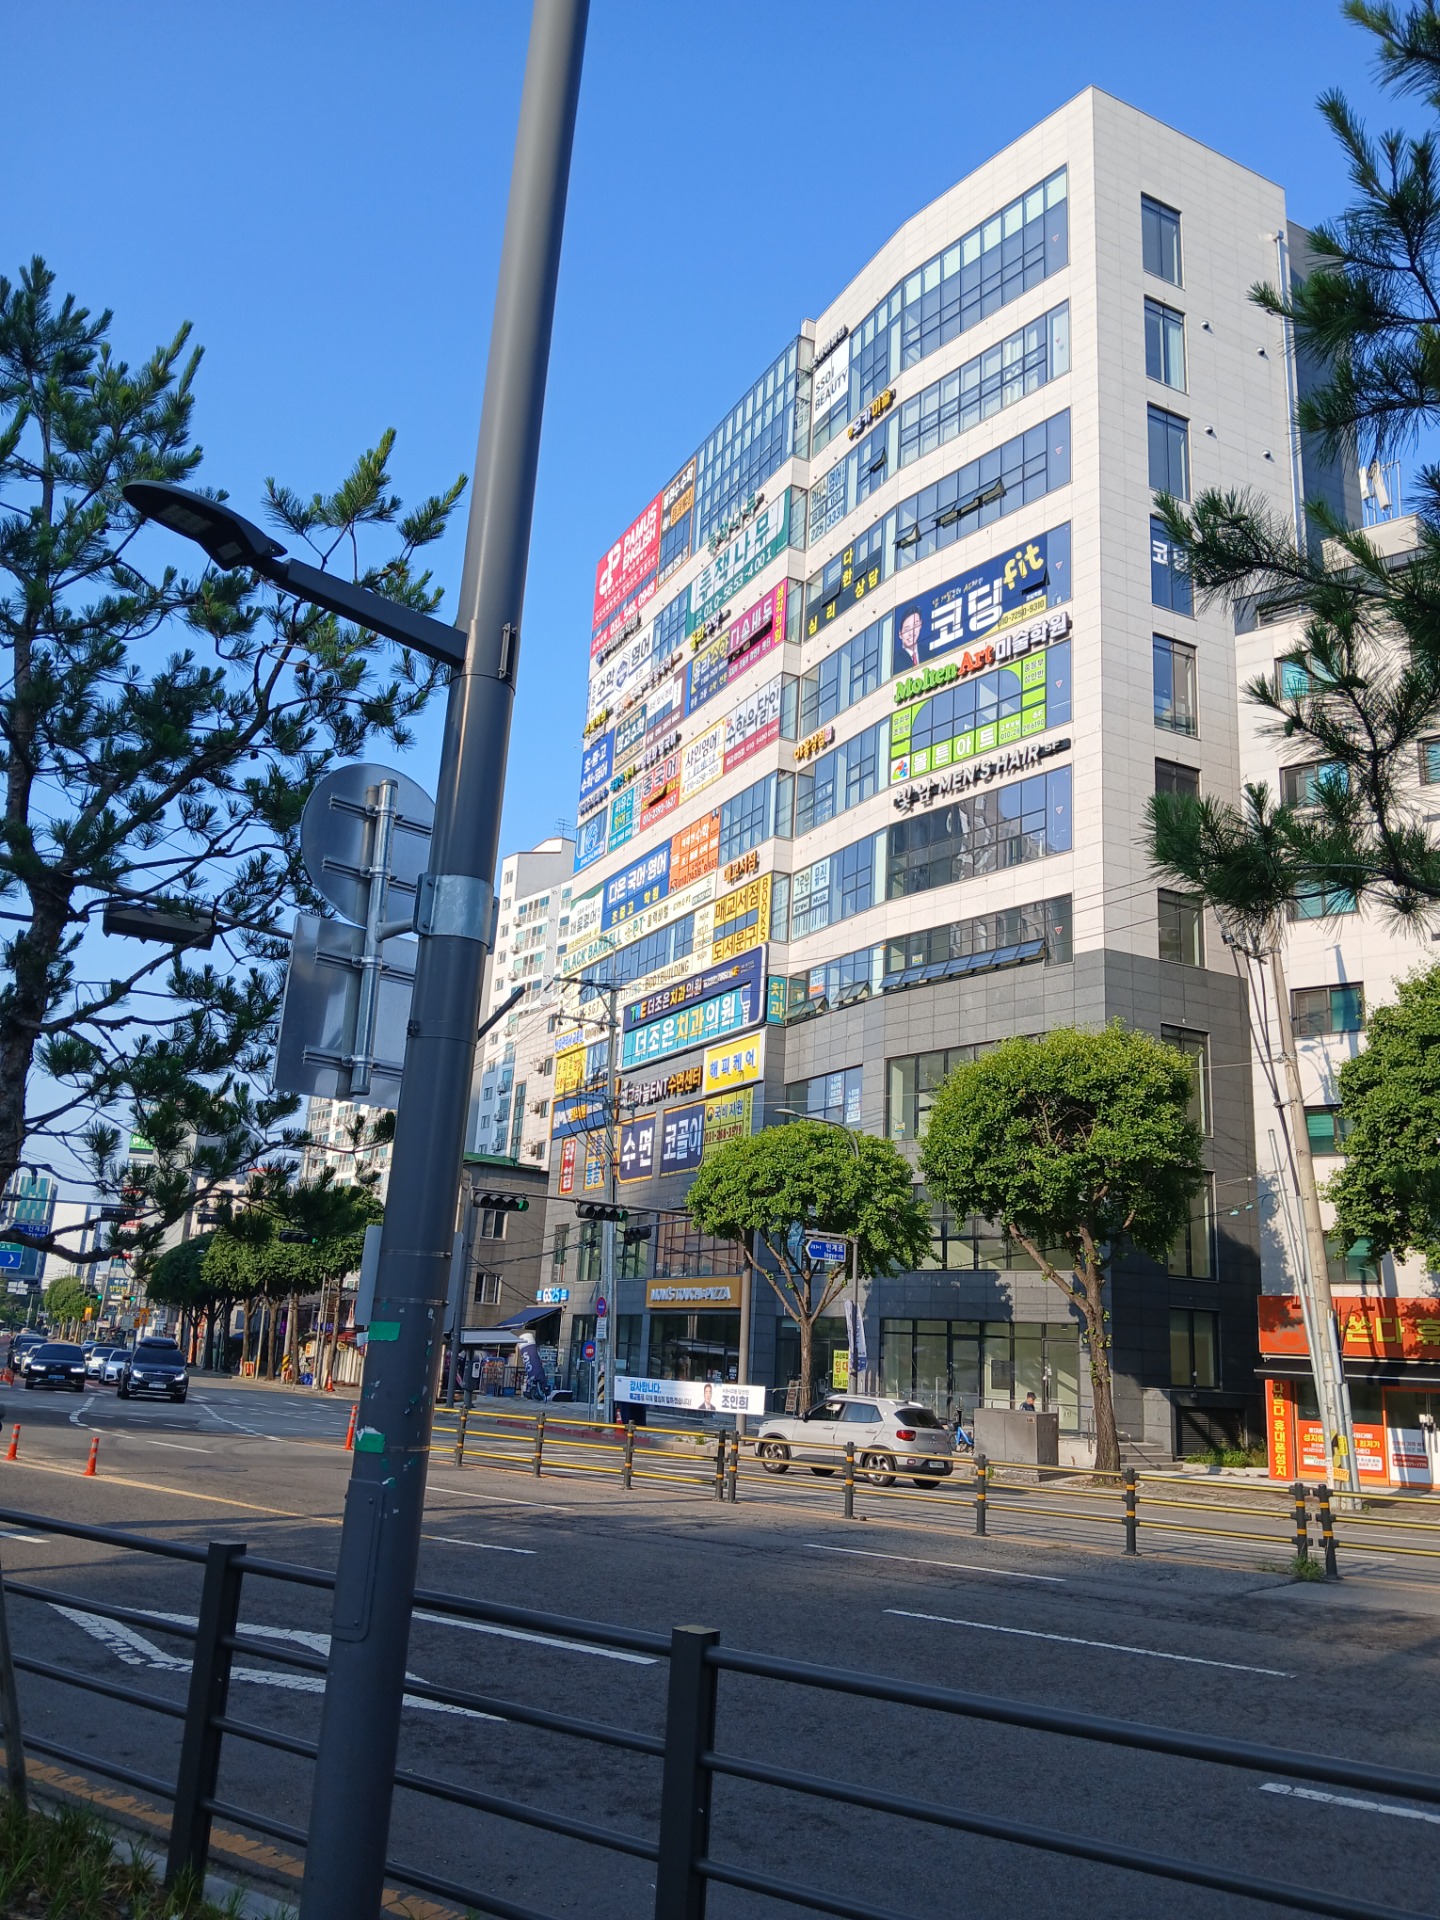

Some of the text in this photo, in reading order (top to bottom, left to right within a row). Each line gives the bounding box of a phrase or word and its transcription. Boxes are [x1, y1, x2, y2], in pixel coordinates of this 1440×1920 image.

[814, 369, 849, 411] BEAUTY
[815, 367, 835, 395] SSOI
[622, 522, 656, 571] ENGLISH
[624, 503, 657, 554] PAMUS
[1003, 543, 1044, 591] fit
[929, 577, 1003, 650] 코딩
[631, 633, 651, 667] 영어
[894, 612, 1068, 703] Molten Art 미술학원
[643, 755, 677, 798] 중국어
[937, 759, 991, 794] MEN'S
[995, 743, 1040, 772] HAIR
[814, 863, 828, 887] 뮤직
[715, 883, 759, 921] 매교서점
[760, 877, 769, 942] BOOKS
[562, 949, 585, 973] BLACK
[588, 929, 622, 961] BARBELL
[713, 927, 757, 961] 도서문구
[770, 982, 785, 1021] 치과
[635, 993, 736, 1057] 더조은치과의원
[709, 1048, 756, 1078] 해피케어
[622, 1127, 653, 1171] 수면
[663, 1114, 703, 1161] 코골이
[825, 1243, 844, 1253] 인계로
[543, 1288, 560, 1303] GS25
[674, 1288, 702, 1300] TOUCH
[1336, 1315, 1405, 1344] 쓴다
[629, 1380, 662, 1394] 감사합니다.
[721, 1394, 749, 1410] 조인희
[1273, 1419, 1287, 1477] 휴대폰성지
